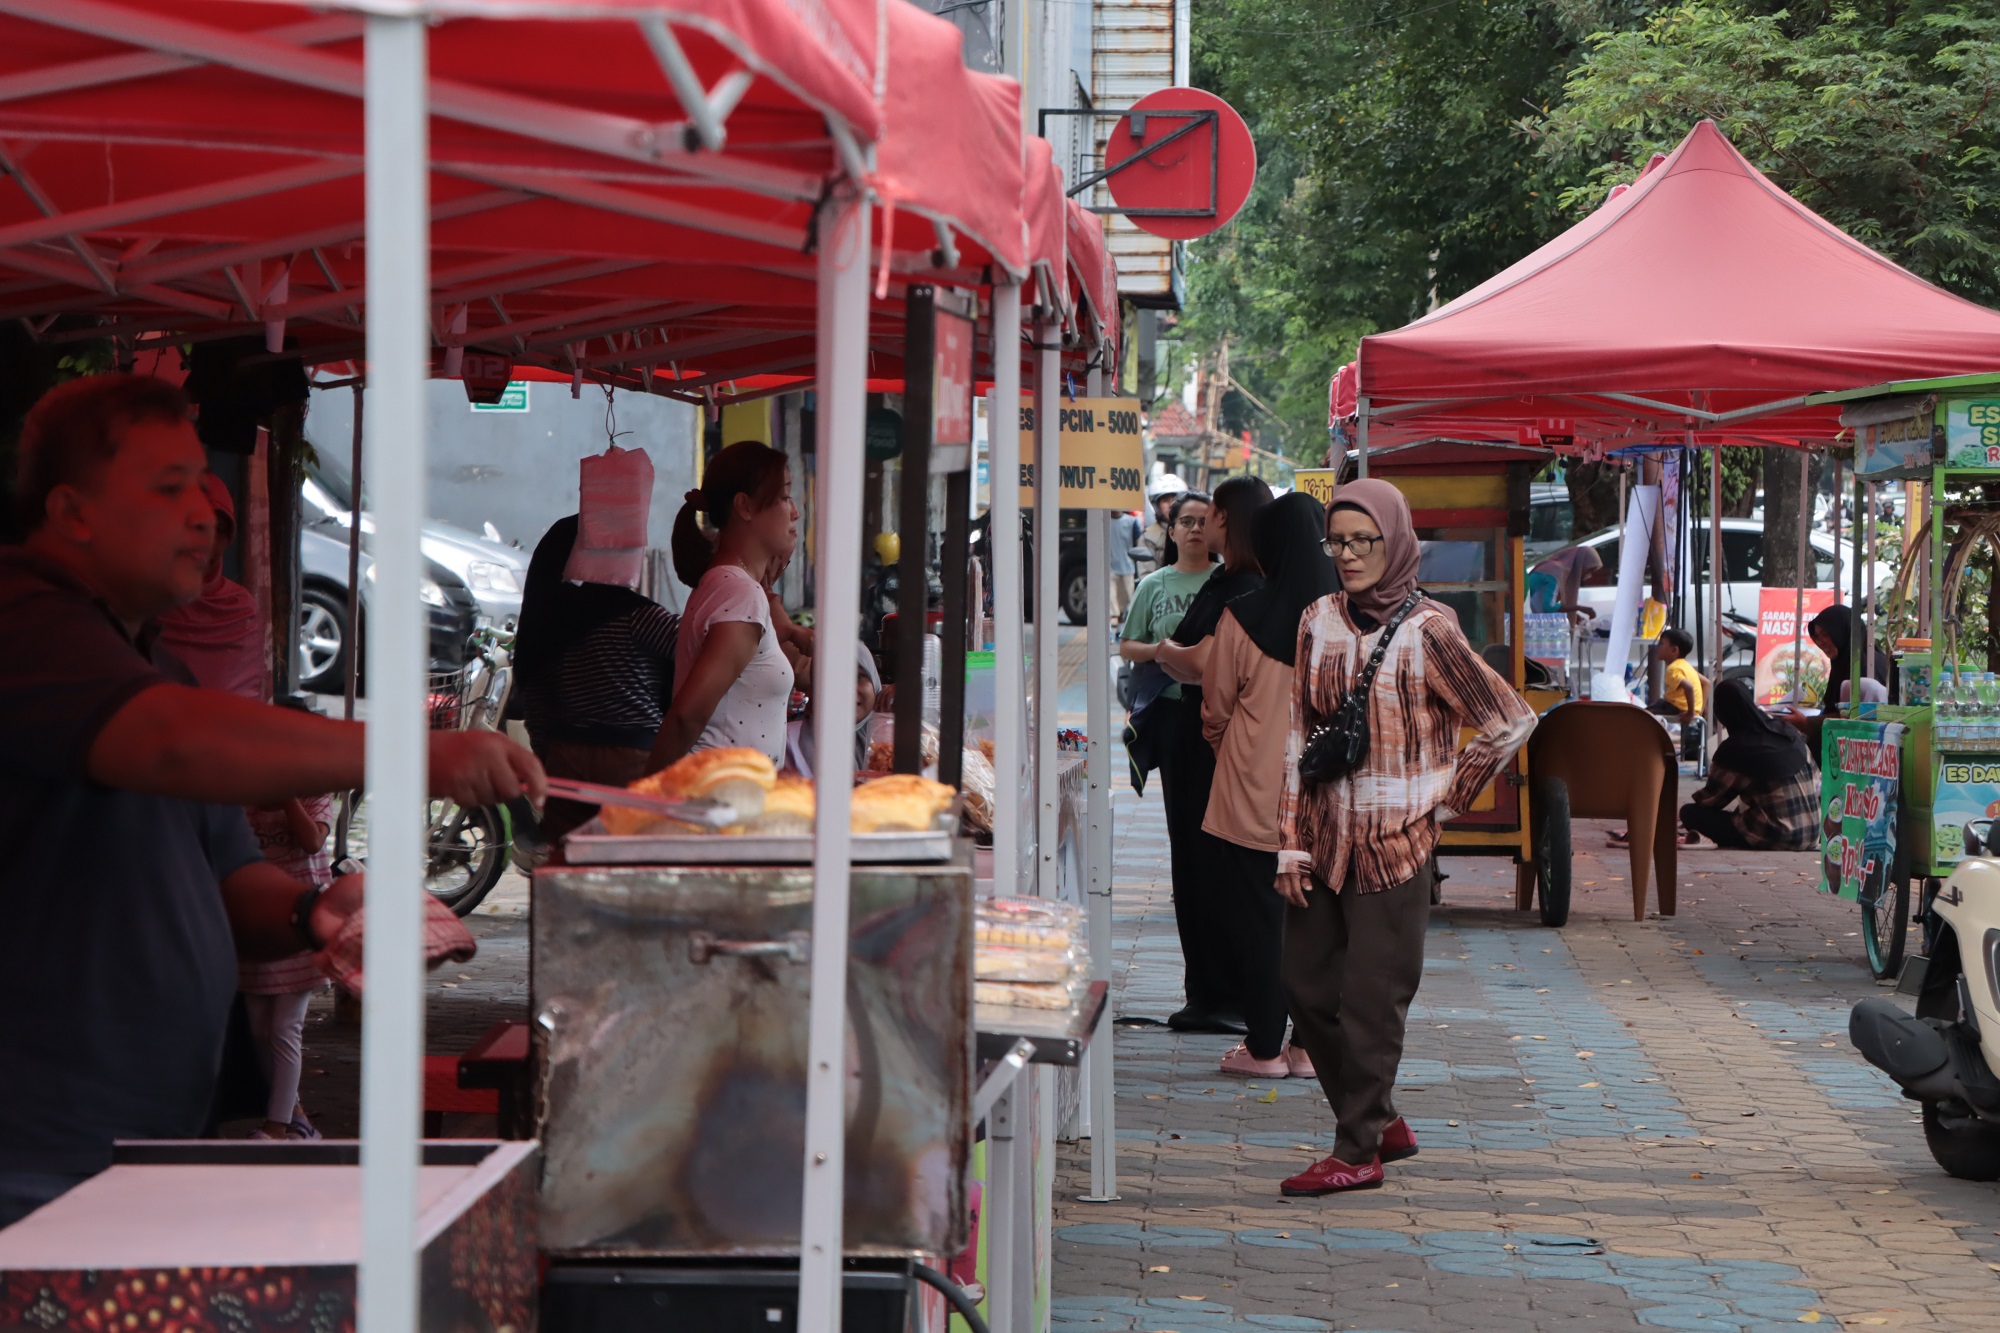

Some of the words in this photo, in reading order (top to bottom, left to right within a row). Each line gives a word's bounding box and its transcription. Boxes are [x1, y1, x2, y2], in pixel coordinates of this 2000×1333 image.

[1059, 409, 1094, 433] PCIN
[1108, 411, 1138, 435] 5000
[1059, 465, 1096, 489] WUT
[1110, 467, 1141, 492] 5000
[1762, 611, 1796, 621] SARAPA
[1761, 621, 1795, 635] NASI
[1946, 766, 1970, 783] ES
